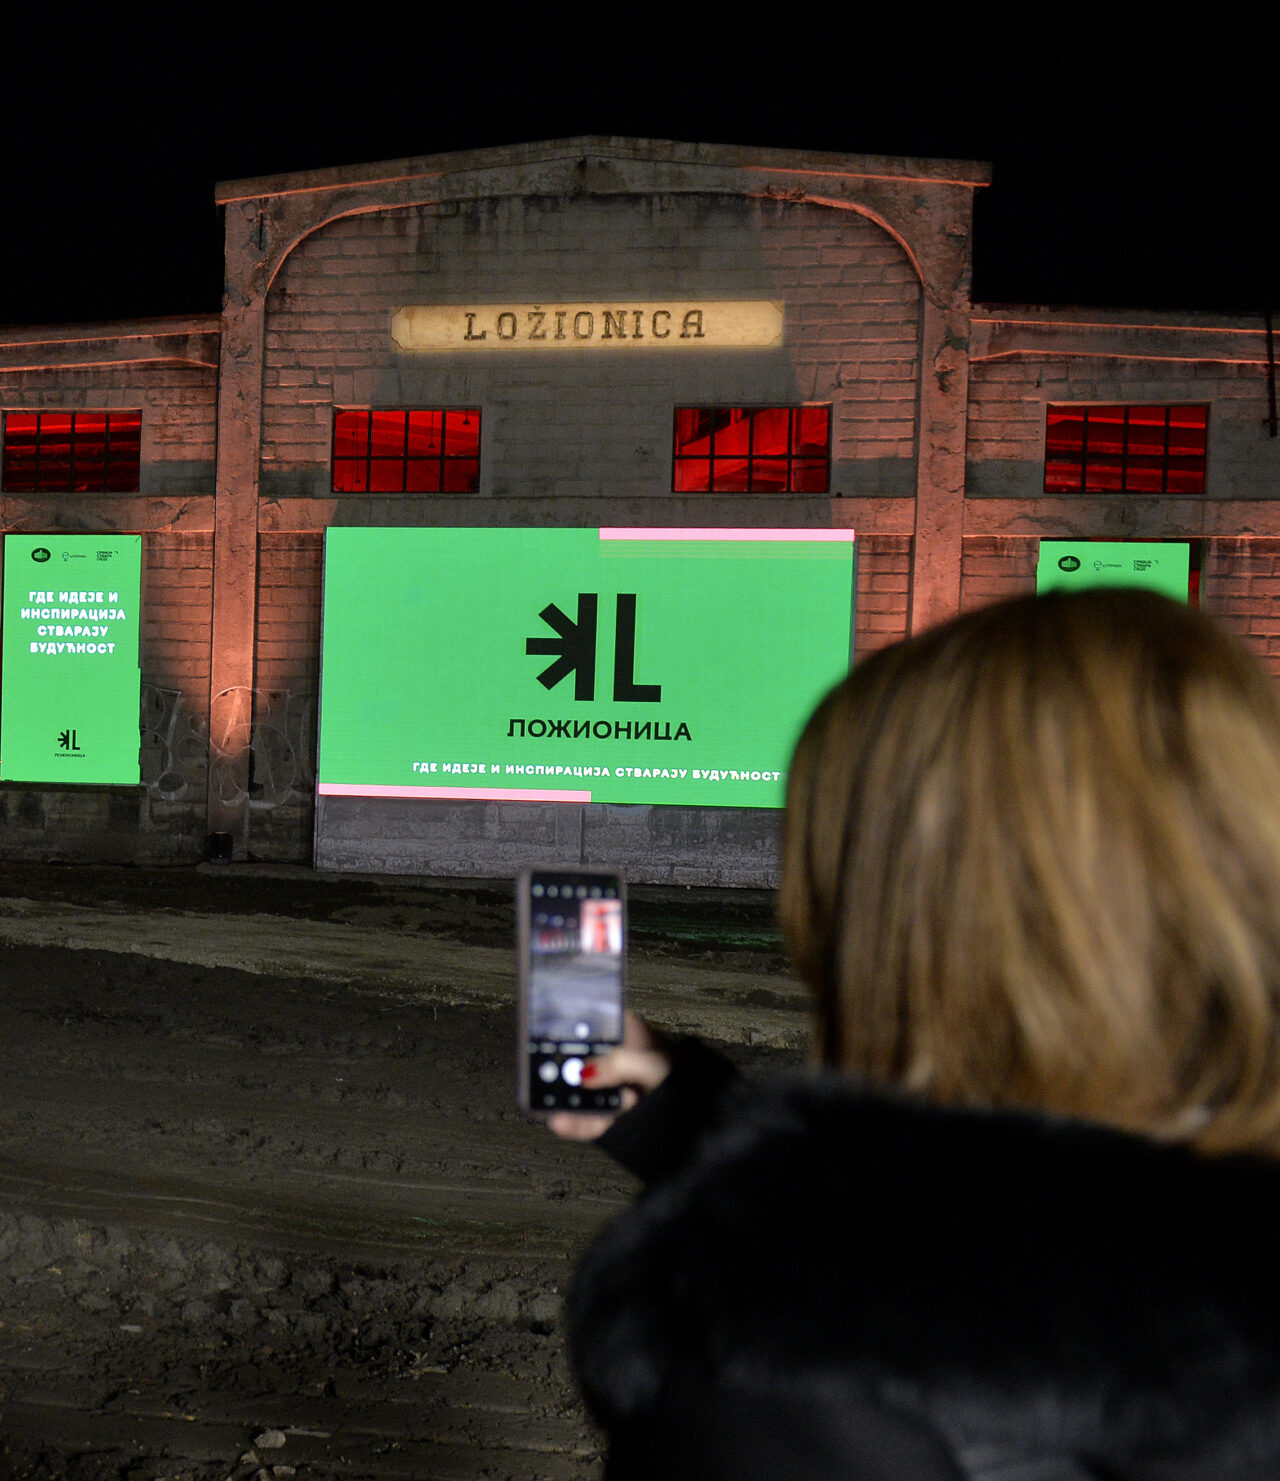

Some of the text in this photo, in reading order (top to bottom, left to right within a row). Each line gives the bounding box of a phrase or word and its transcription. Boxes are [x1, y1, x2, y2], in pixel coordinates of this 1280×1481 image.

[463, 305, 706, 342] LOŽIONICA
[28, 591, 119, 604] ГДЕ ИДЕЈЕ И
[20, 608, 126, 621] ИНСПИРАЦИЈА
[37, 625, 109, 637] СТВАРАЈУ
[29, 642, 116, 654] БУДУЋНОСТ
[506, 718, 692, 741] ЛОЖИОНИЦА
[412, 762, 781, 782] ГДЕ ИДЕЈЕ И ИНСПИРАЦИЈА СТВАРАЈУ БУДУЋНОСТ
